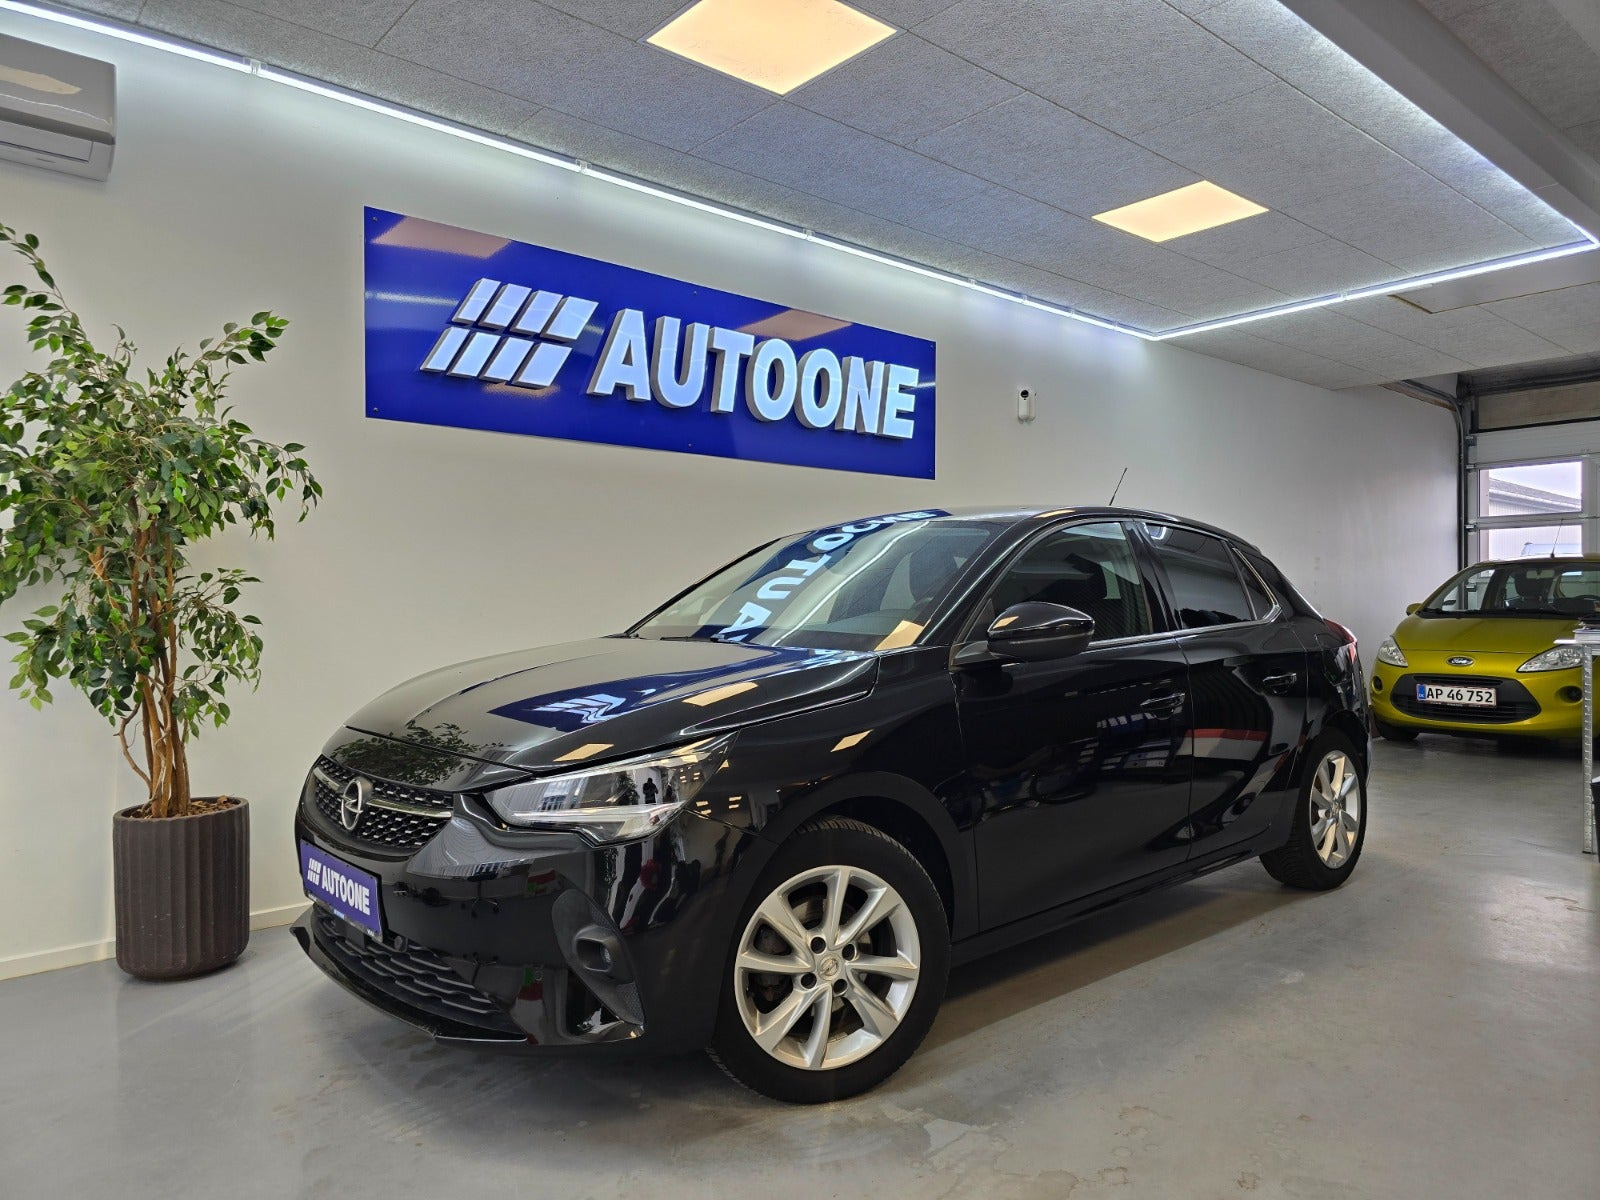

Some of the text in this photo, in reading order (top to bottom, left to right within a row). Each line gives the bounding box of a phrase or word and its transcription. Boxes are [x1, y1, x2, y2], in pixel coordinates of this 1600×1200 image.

[588, 309, 920, 439] AUTOONE
[1427, 687, 1493, 703] AP 46 752
[322, 865, 371, 915] AUTOONE
